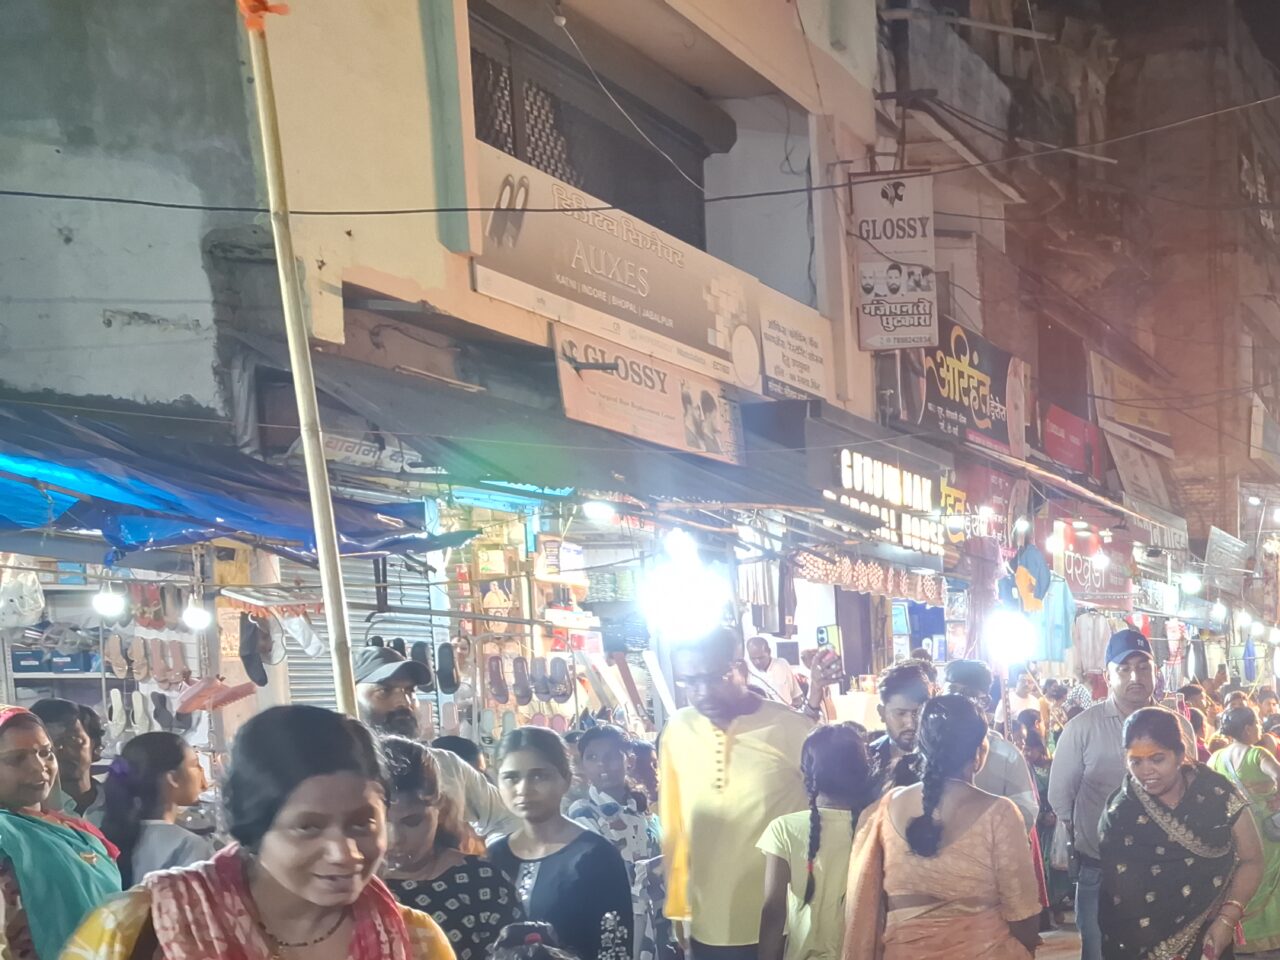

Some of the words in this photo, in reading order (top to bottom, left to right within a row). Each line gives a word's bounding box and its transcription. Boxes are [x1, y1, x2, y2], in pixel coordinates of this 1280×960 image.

[858, 216, 931, 241] GLOSSY
[570, 238, 649, 298] AUXES
[611, 295, 637, 315] BHOPAL
[583, 344, 668, 395] GLOSSY
